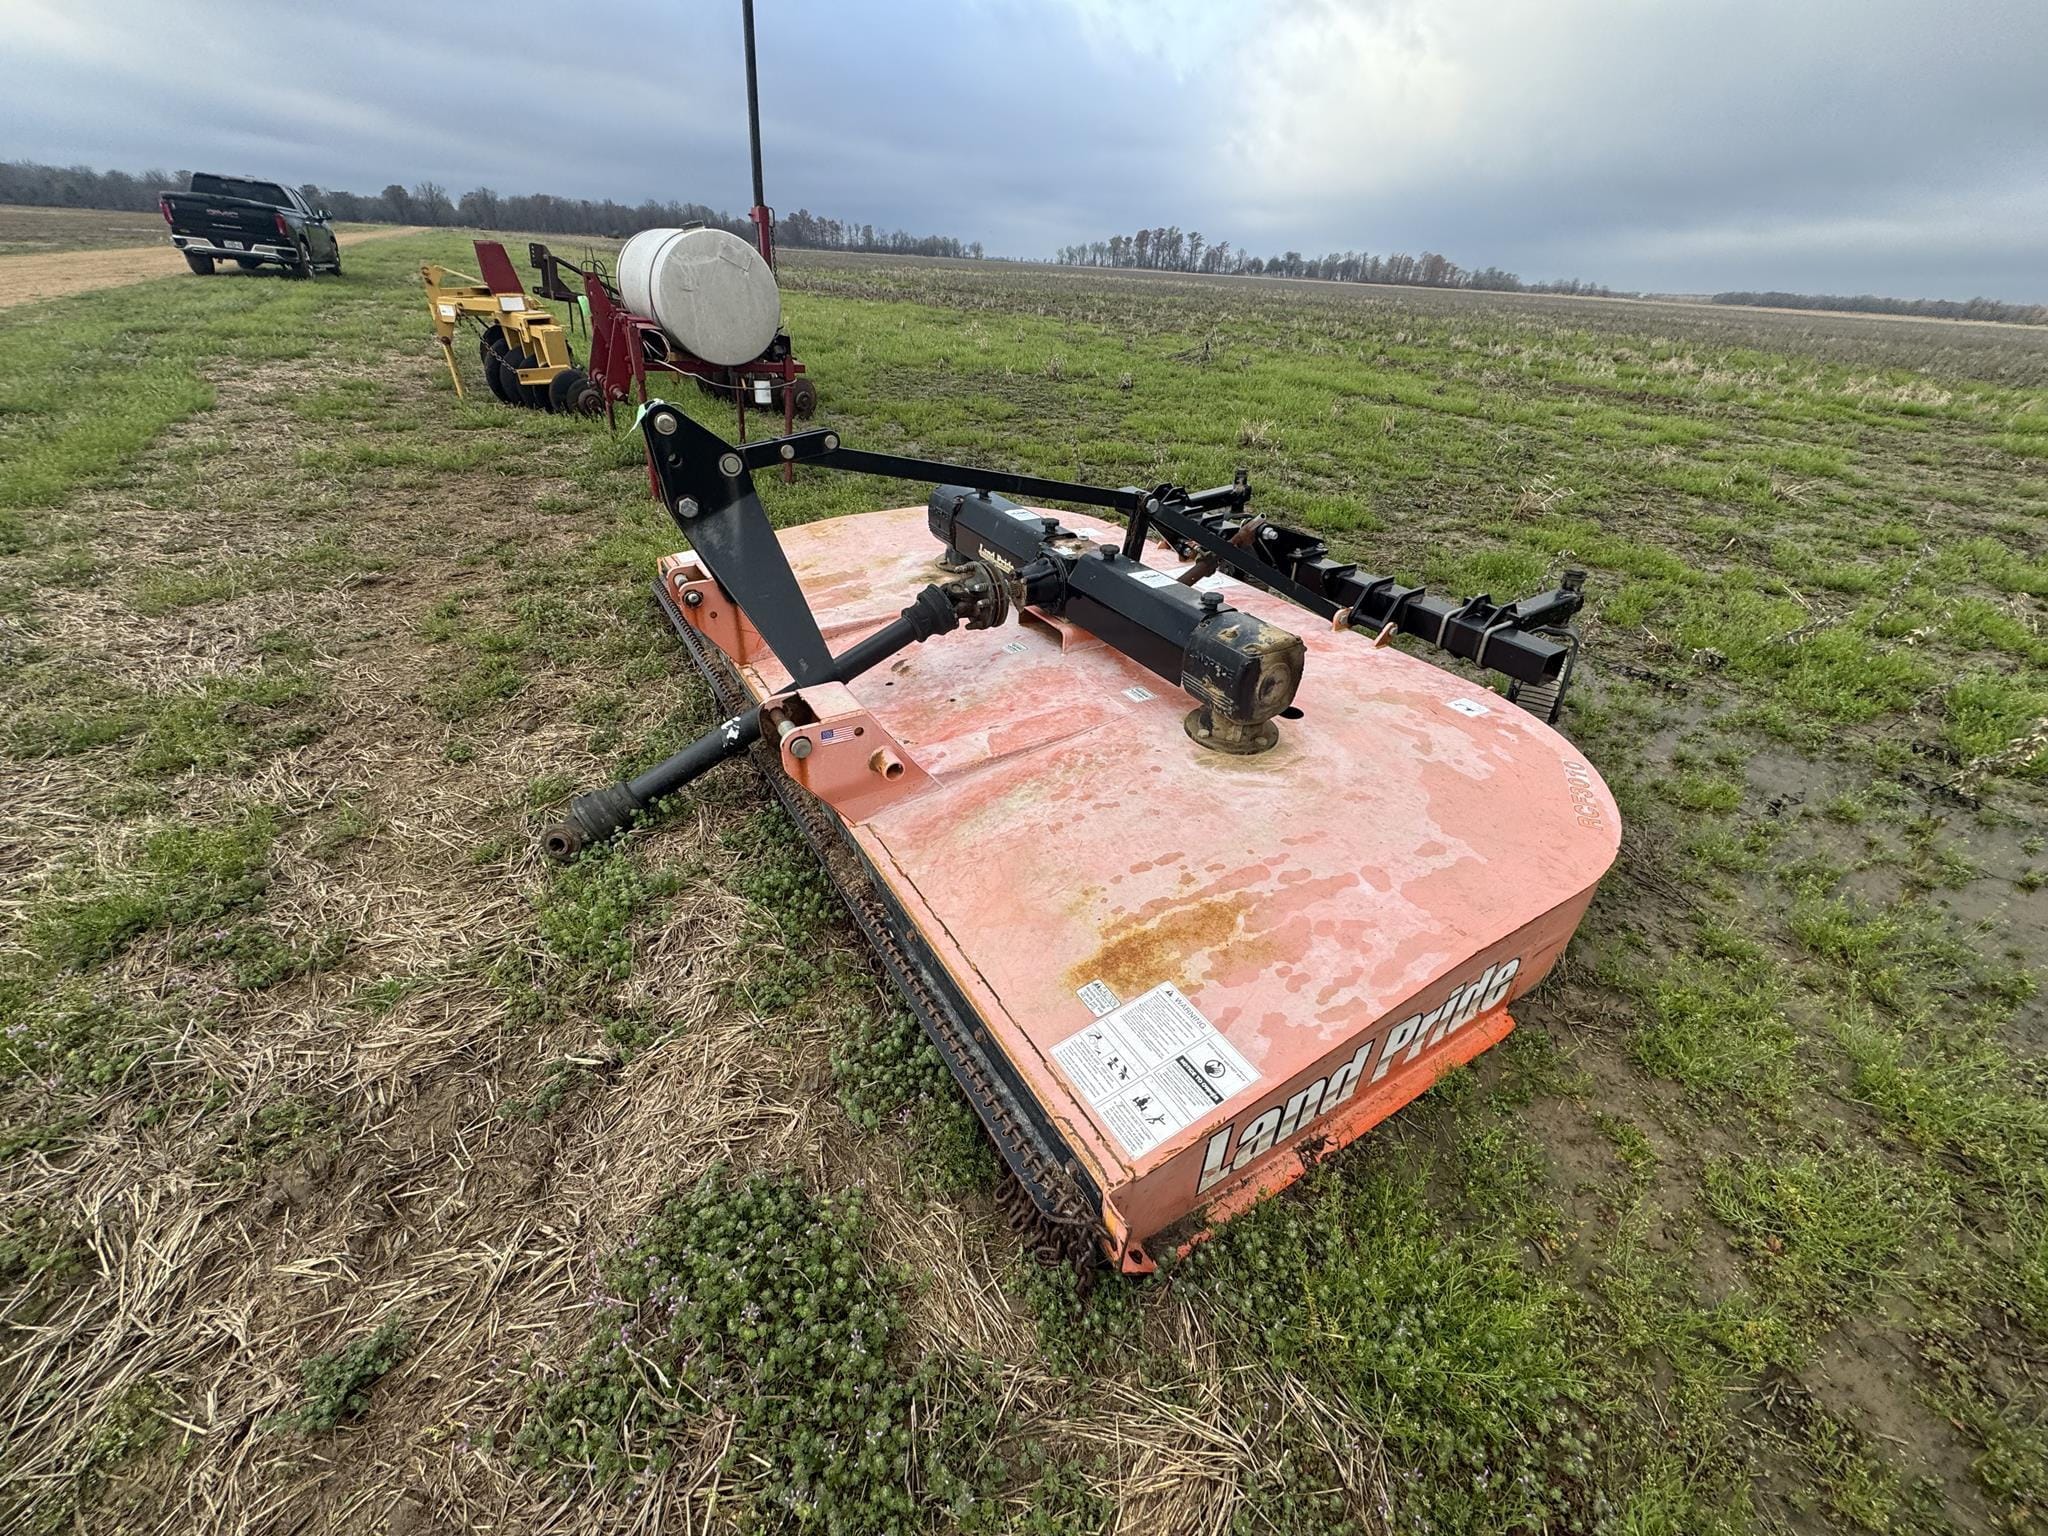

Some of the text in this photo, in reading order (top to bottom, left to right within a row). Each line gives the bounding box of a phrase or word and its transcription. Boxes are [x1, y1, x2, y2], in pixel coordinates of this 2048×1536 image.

[205, 208, 240, 219] GMC
[1173, 996, 1207, 1030] WARNING
[1178, 1057, 1198, 1077] NOTICE
[1196, 1038, 1375, 1196] Land
[1371, 957, 1521, 1084] Pride
